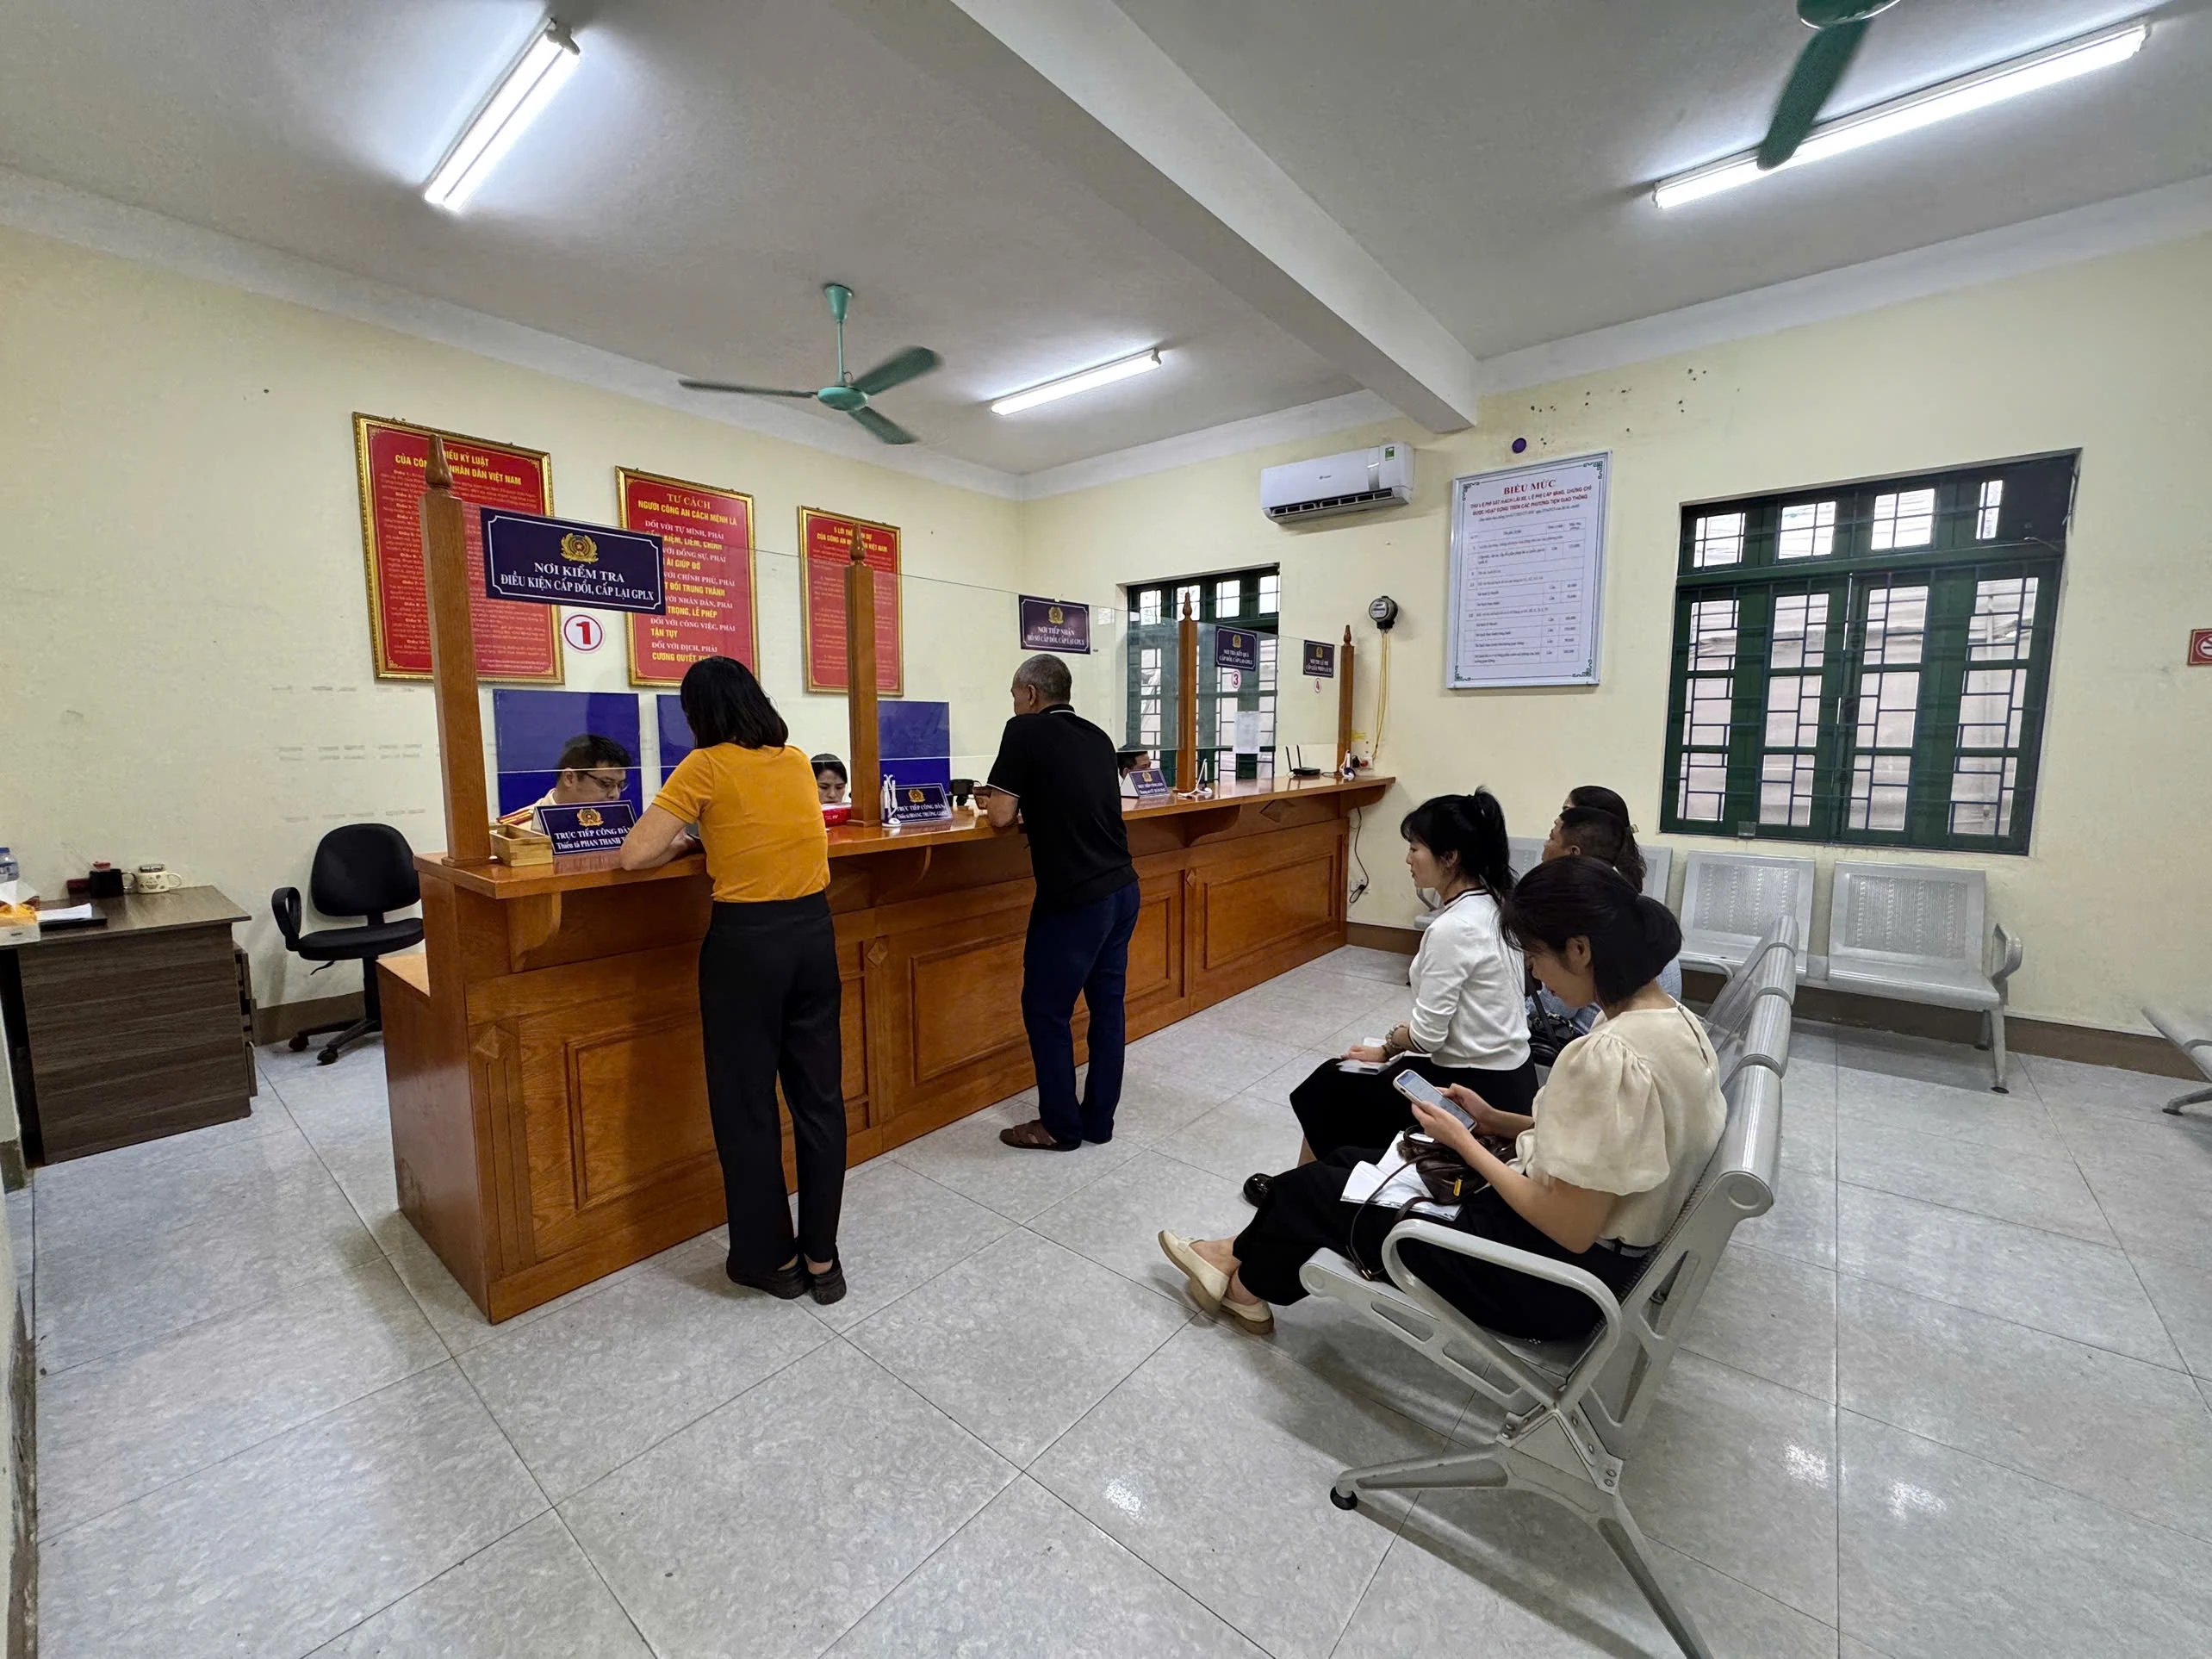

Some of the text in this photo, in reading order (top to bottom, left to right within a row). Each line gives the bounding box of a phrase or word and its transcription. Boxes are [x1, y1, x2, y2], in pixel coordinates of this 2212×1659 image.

[471, 455, 489, 467] LUẬT
[395, 452, 412, 465] CỦA
[413, 457, 427, 468] CÔN
[488, 471, 504, 482] VIỆT
[505, 475, 522, 485] NAM
[1531, 479, 1556, 490] MỨC
[667, 493, 711, 510] TƯ CÁCH
[661, 504, 680, 515] CÔNG
[680, 508, 690, 517] AN
[692, 510, 709, 520] CÁCH
[645, 519, 659, 528] ĐỐI
[660, 522, 674, 531] VỚI
[674, 525, 686, 534] TỰ
[708, 530, 724, 540] PHẢI
[534, 562, 624, 583] NƠI KIỂM TRA
[500, 570, 655, 601] ĐIỀU KIỆN CẤP ĐỔI, CẤP LẠI GPLX
[683, 584, 704, 593] TRUNG
[705, 586, 725, 596] THÀNH
[701, 609, 718, 618] PHÉP
[680, 619, 699, 628] CÔNG
[576, 621, 591, 645] 1
[650, 627, 664, 638] TẬN
[652, 640, 665, 649] ĐỐI
[1233, 674, 1239, 685] 3
[1316, 680, 1320, 690] 4
[554, 830, 576, 840] TRỰC
[577, 827, 594, 838] TIẾP
[595, 827, 617, 836] CÔNG
[556, 841, 573, 850] Thiếu
[580, 839, 599, 848] PHAN
[599, 837, 621, 846] THANH
